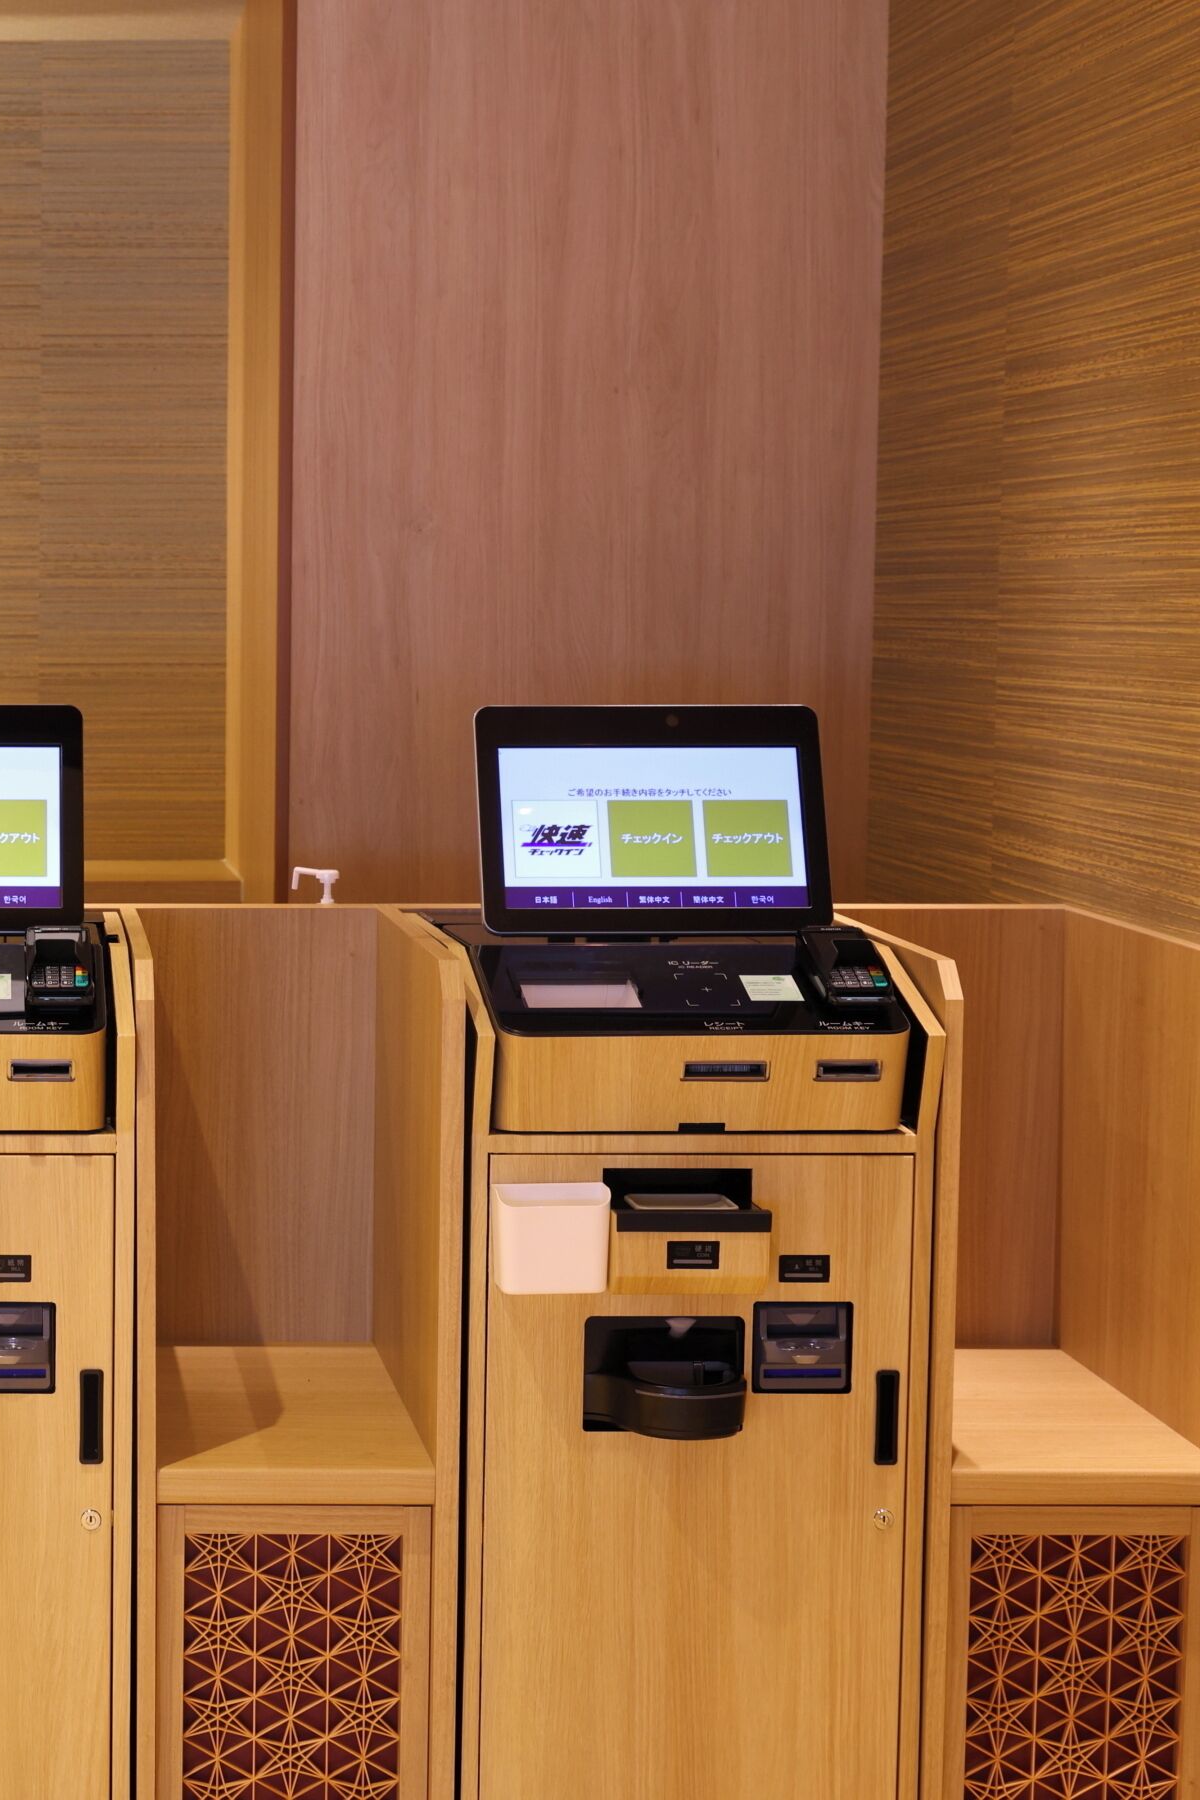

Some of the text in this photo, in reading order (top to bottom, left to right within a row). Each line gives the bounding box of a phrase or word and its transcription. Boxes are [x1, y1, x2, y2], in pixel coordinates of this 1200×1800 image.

[567, 787, 732, 797] ご希望のお手続き内容をタッチしてください
[531, 823, 592, 844] 快速
[621, 832, 682, 845] チェックイン
[712, 832, 784, 845] チェックアウト
[528, 847, 583, 856] チェックイン
[3, 895, 27, 904] 한국어
[534, 895, 558, 904] 日本語
[588, 895, 613, 904] English
[751, 895, 774, 905] 한국어
